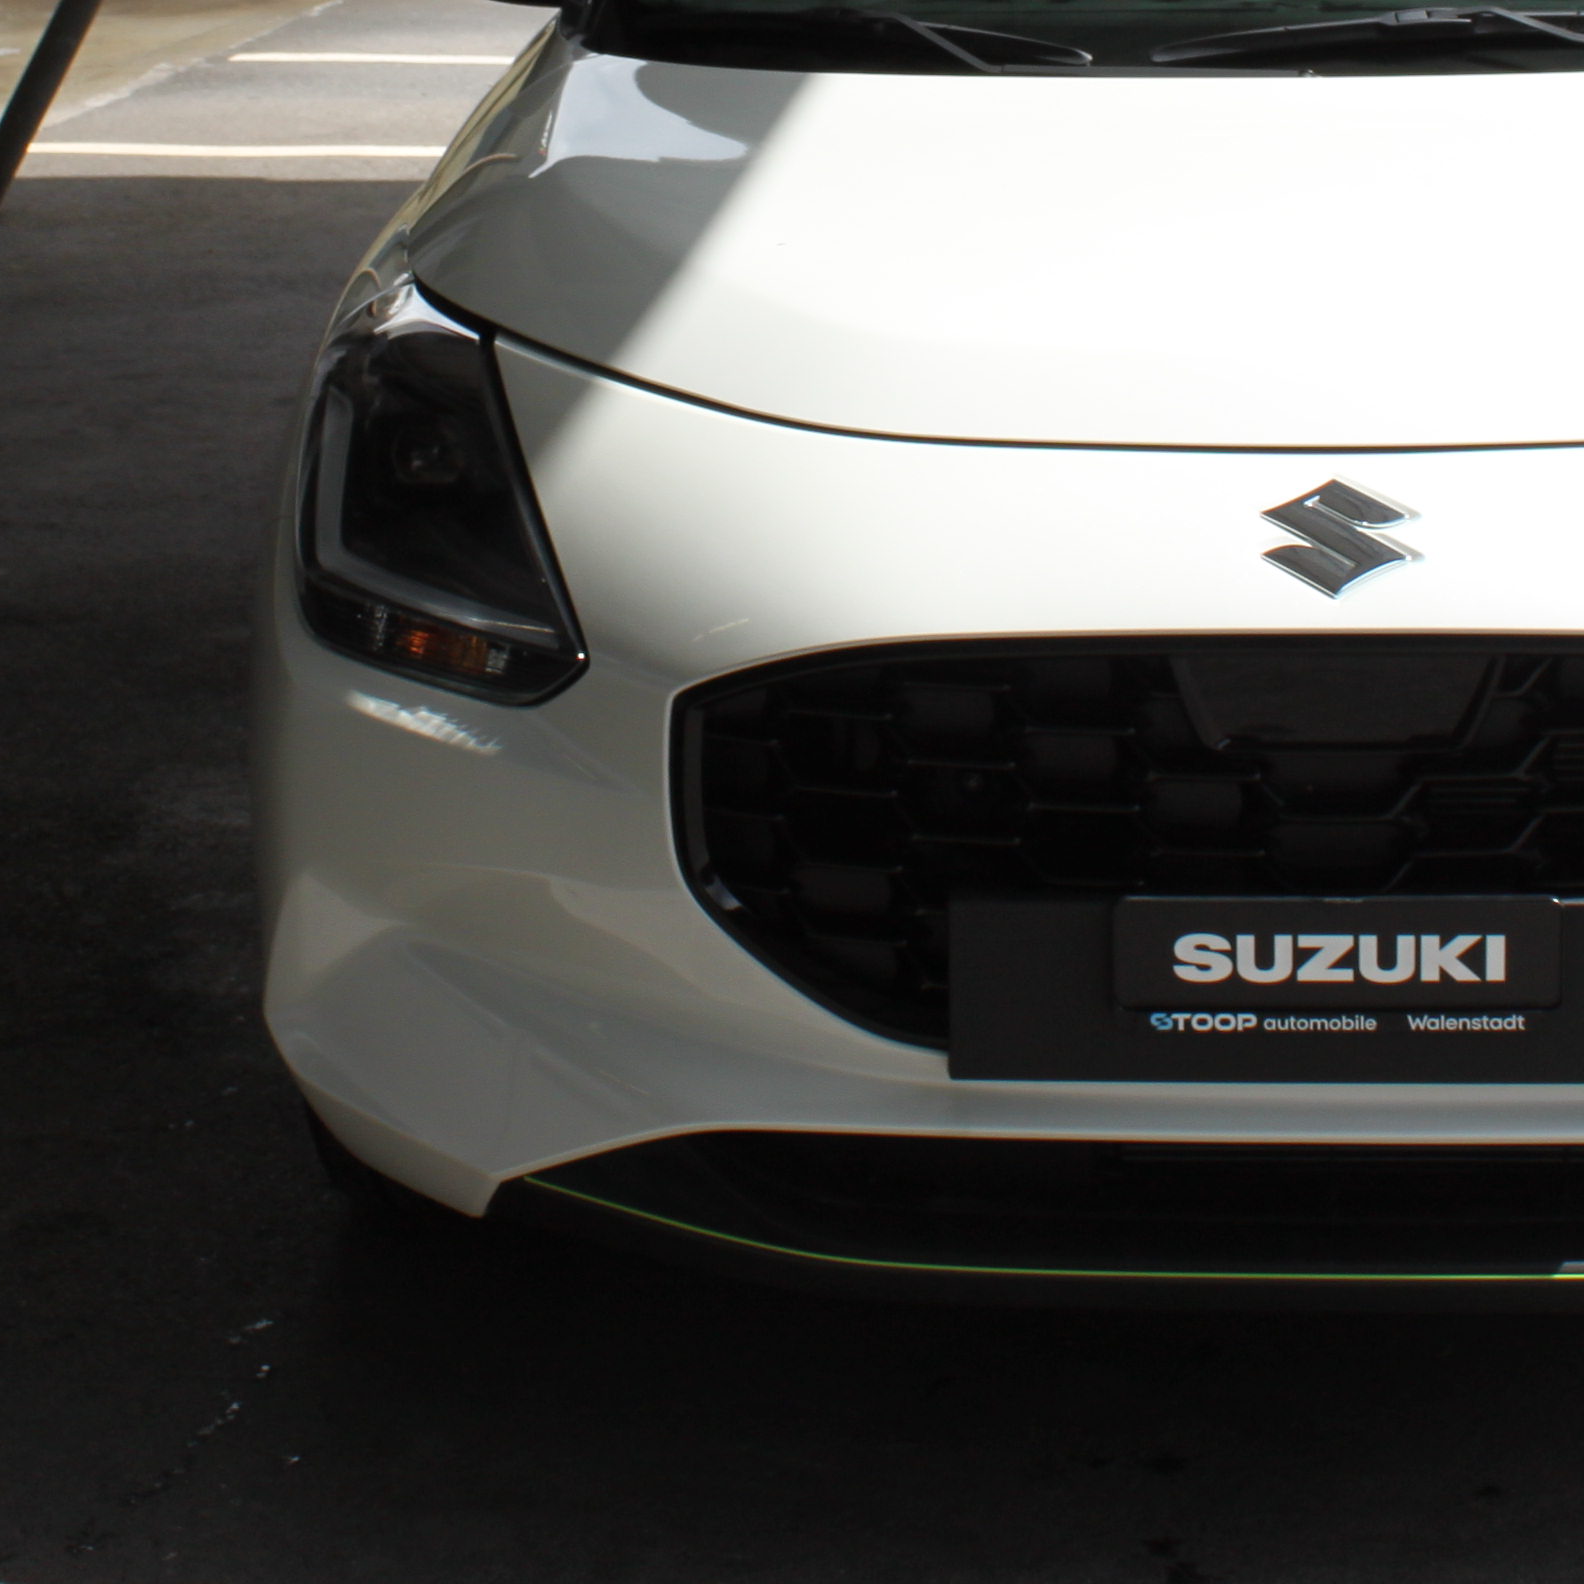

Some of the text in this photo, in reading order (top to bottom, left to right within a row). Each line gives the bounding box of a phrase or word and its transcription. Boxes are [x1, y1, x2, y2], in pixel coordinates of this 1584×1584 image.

[1172, 932, 1507, 984] SUZUKI
[1150, 1013, 1526, 1032] STOOP automobile Walenstadt
